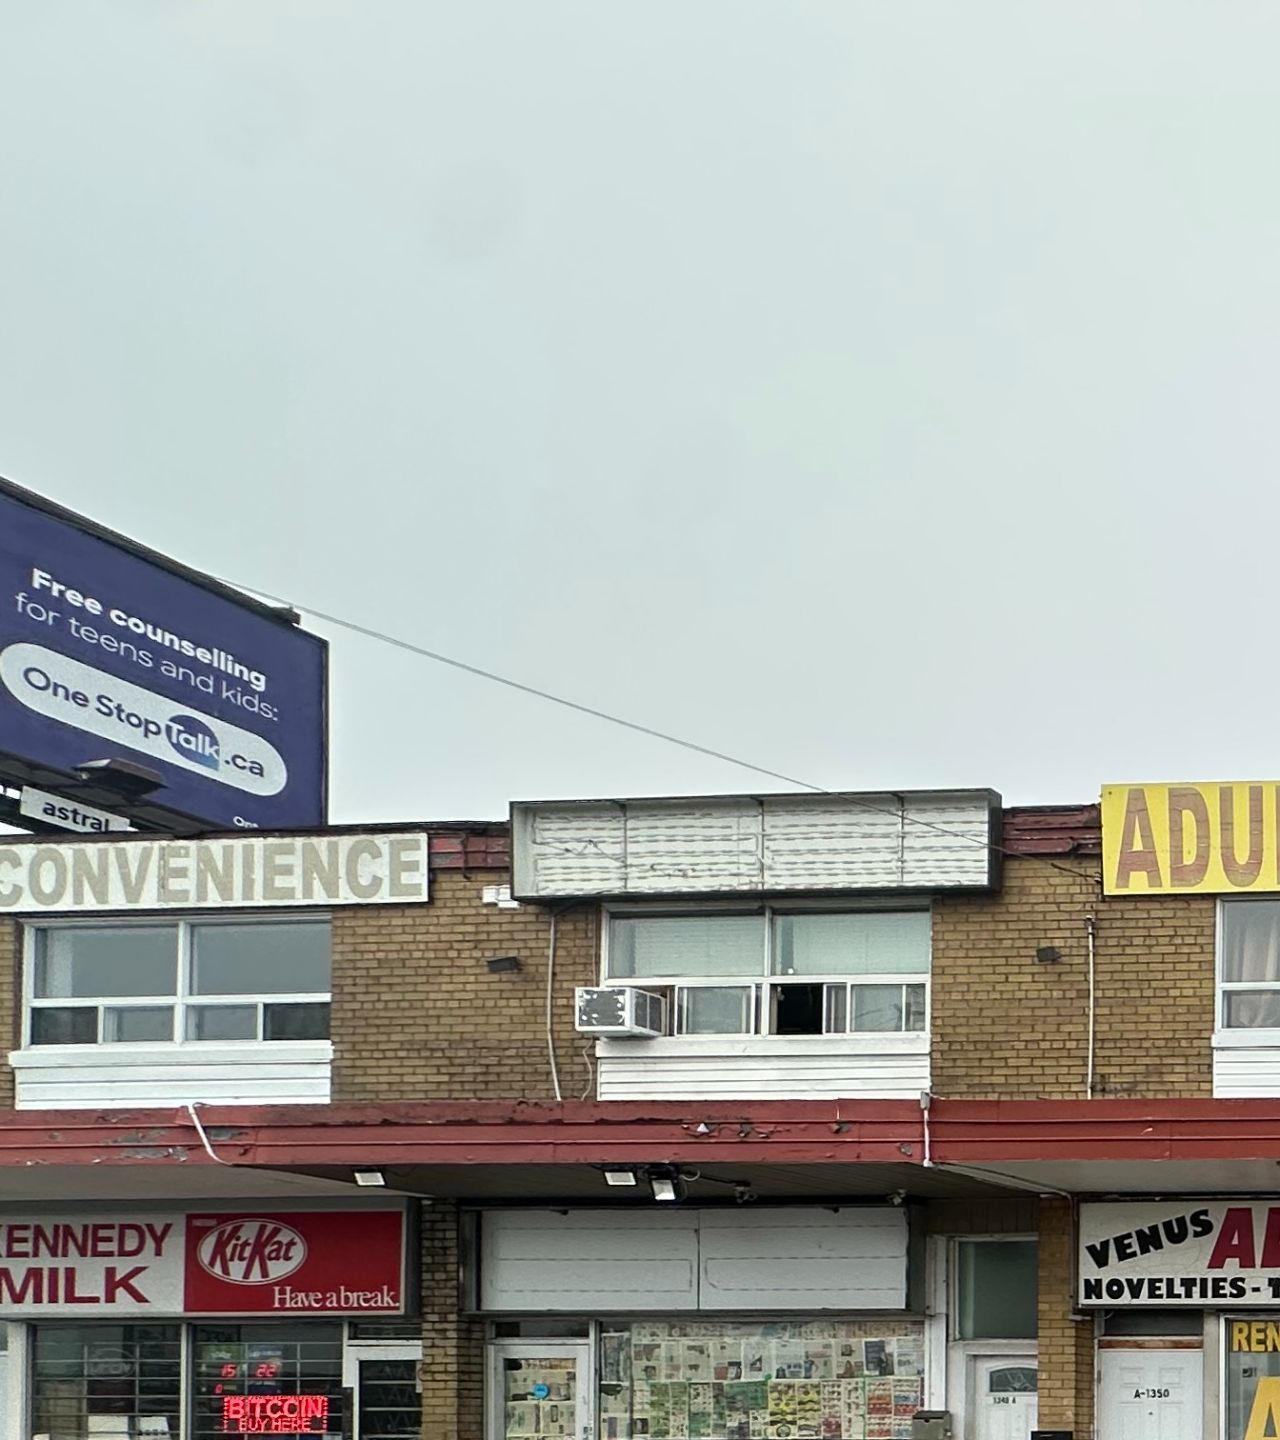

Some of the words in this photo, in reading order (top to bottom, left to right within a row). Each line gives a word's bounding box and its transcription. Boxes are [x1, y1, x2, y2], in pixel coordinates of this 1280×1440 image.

[32, 568, 103, 615] Free
[110, 609, 267, 692] counselling
[15, 593, 60, 626] for
[69, 617, 153, 667] teens
[161, 660, 214, 694] and
[221, 681, 278, 721] kids:
[23, 667, 90, 708] One
[43, 800, 110, 832] astral
[0, 838, 422, 907] CONVENIENCE
[0, 1223, 172, 1259] ENNEDY
[208, 1224, 298, 1280] KitKat
[1085, 1209, 1214, 1269] VENUS
[0, 1266, 151, 1304] MILK
[273, 1286, 323, 1308] Have
[326, 1292, 337, 1308] a
[338, 1284, 400, 1308] break.
[255, 1364, 277, 1377] 22
[1134, 1388, 1170, 1398] A-1350
